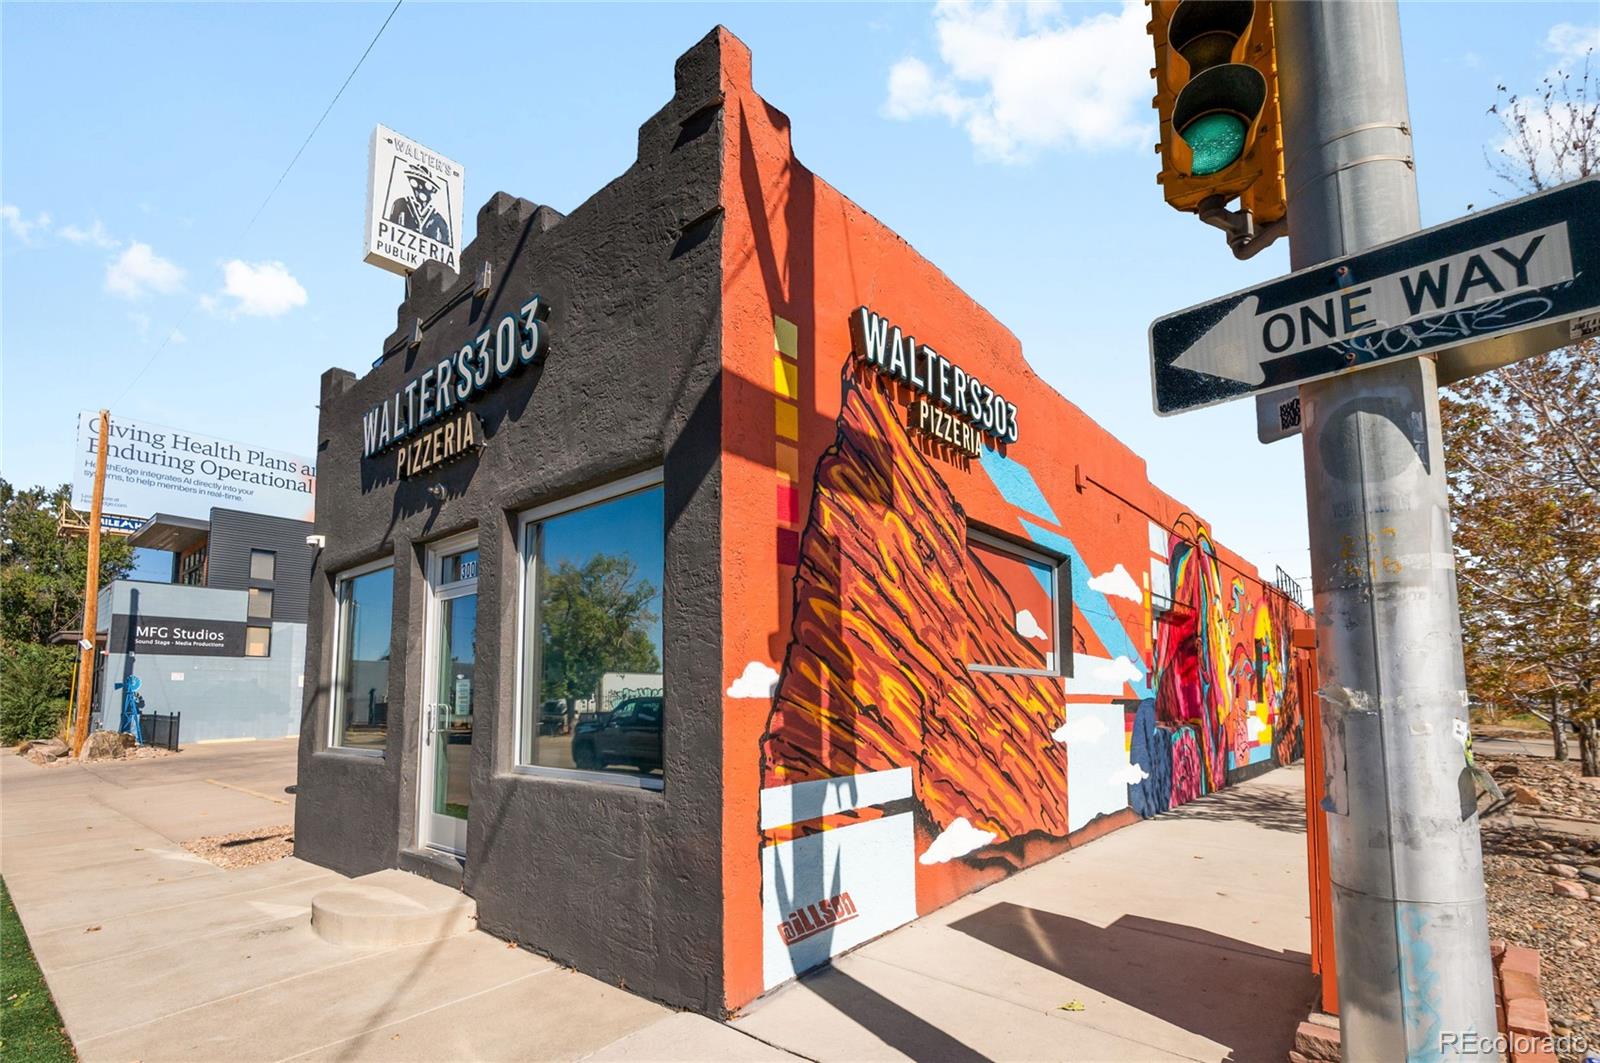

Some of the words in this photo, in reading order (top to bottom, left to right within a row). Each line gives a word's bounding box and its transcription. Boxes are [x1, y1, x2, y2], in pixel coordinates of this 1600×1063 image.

[377, 240, 418, 265] PUBLIK
[378, 222, 455, 266] PIZZERIA
[1262, 286, 1377, 353] ONE
[1399, 234, 1546, 316] WAY
[88, 417, 166, 450] Giving
[171, 433, 242, 462] Health
[246, 449, 297, 474] Plans
[396, 411, 474, 480] PIZZERIA
[920, 400, 983, 458] PIZZERIA
[86, 436, 195, 475] Enduring
[200, 459, 313, 494] Operational
[126, 475, 135, 483] to
[136, 476, 156, 488] help
[157, 481, 198, 495] members
[198, 487, 206, 495] in
[140, 469, 182, 482] integrates
[193, 478, 222, 491] directly
[136, 626, 168, 638] MFG
[173, 628, 224, 640] Studios
[154, 639, 170, 647] Stage
